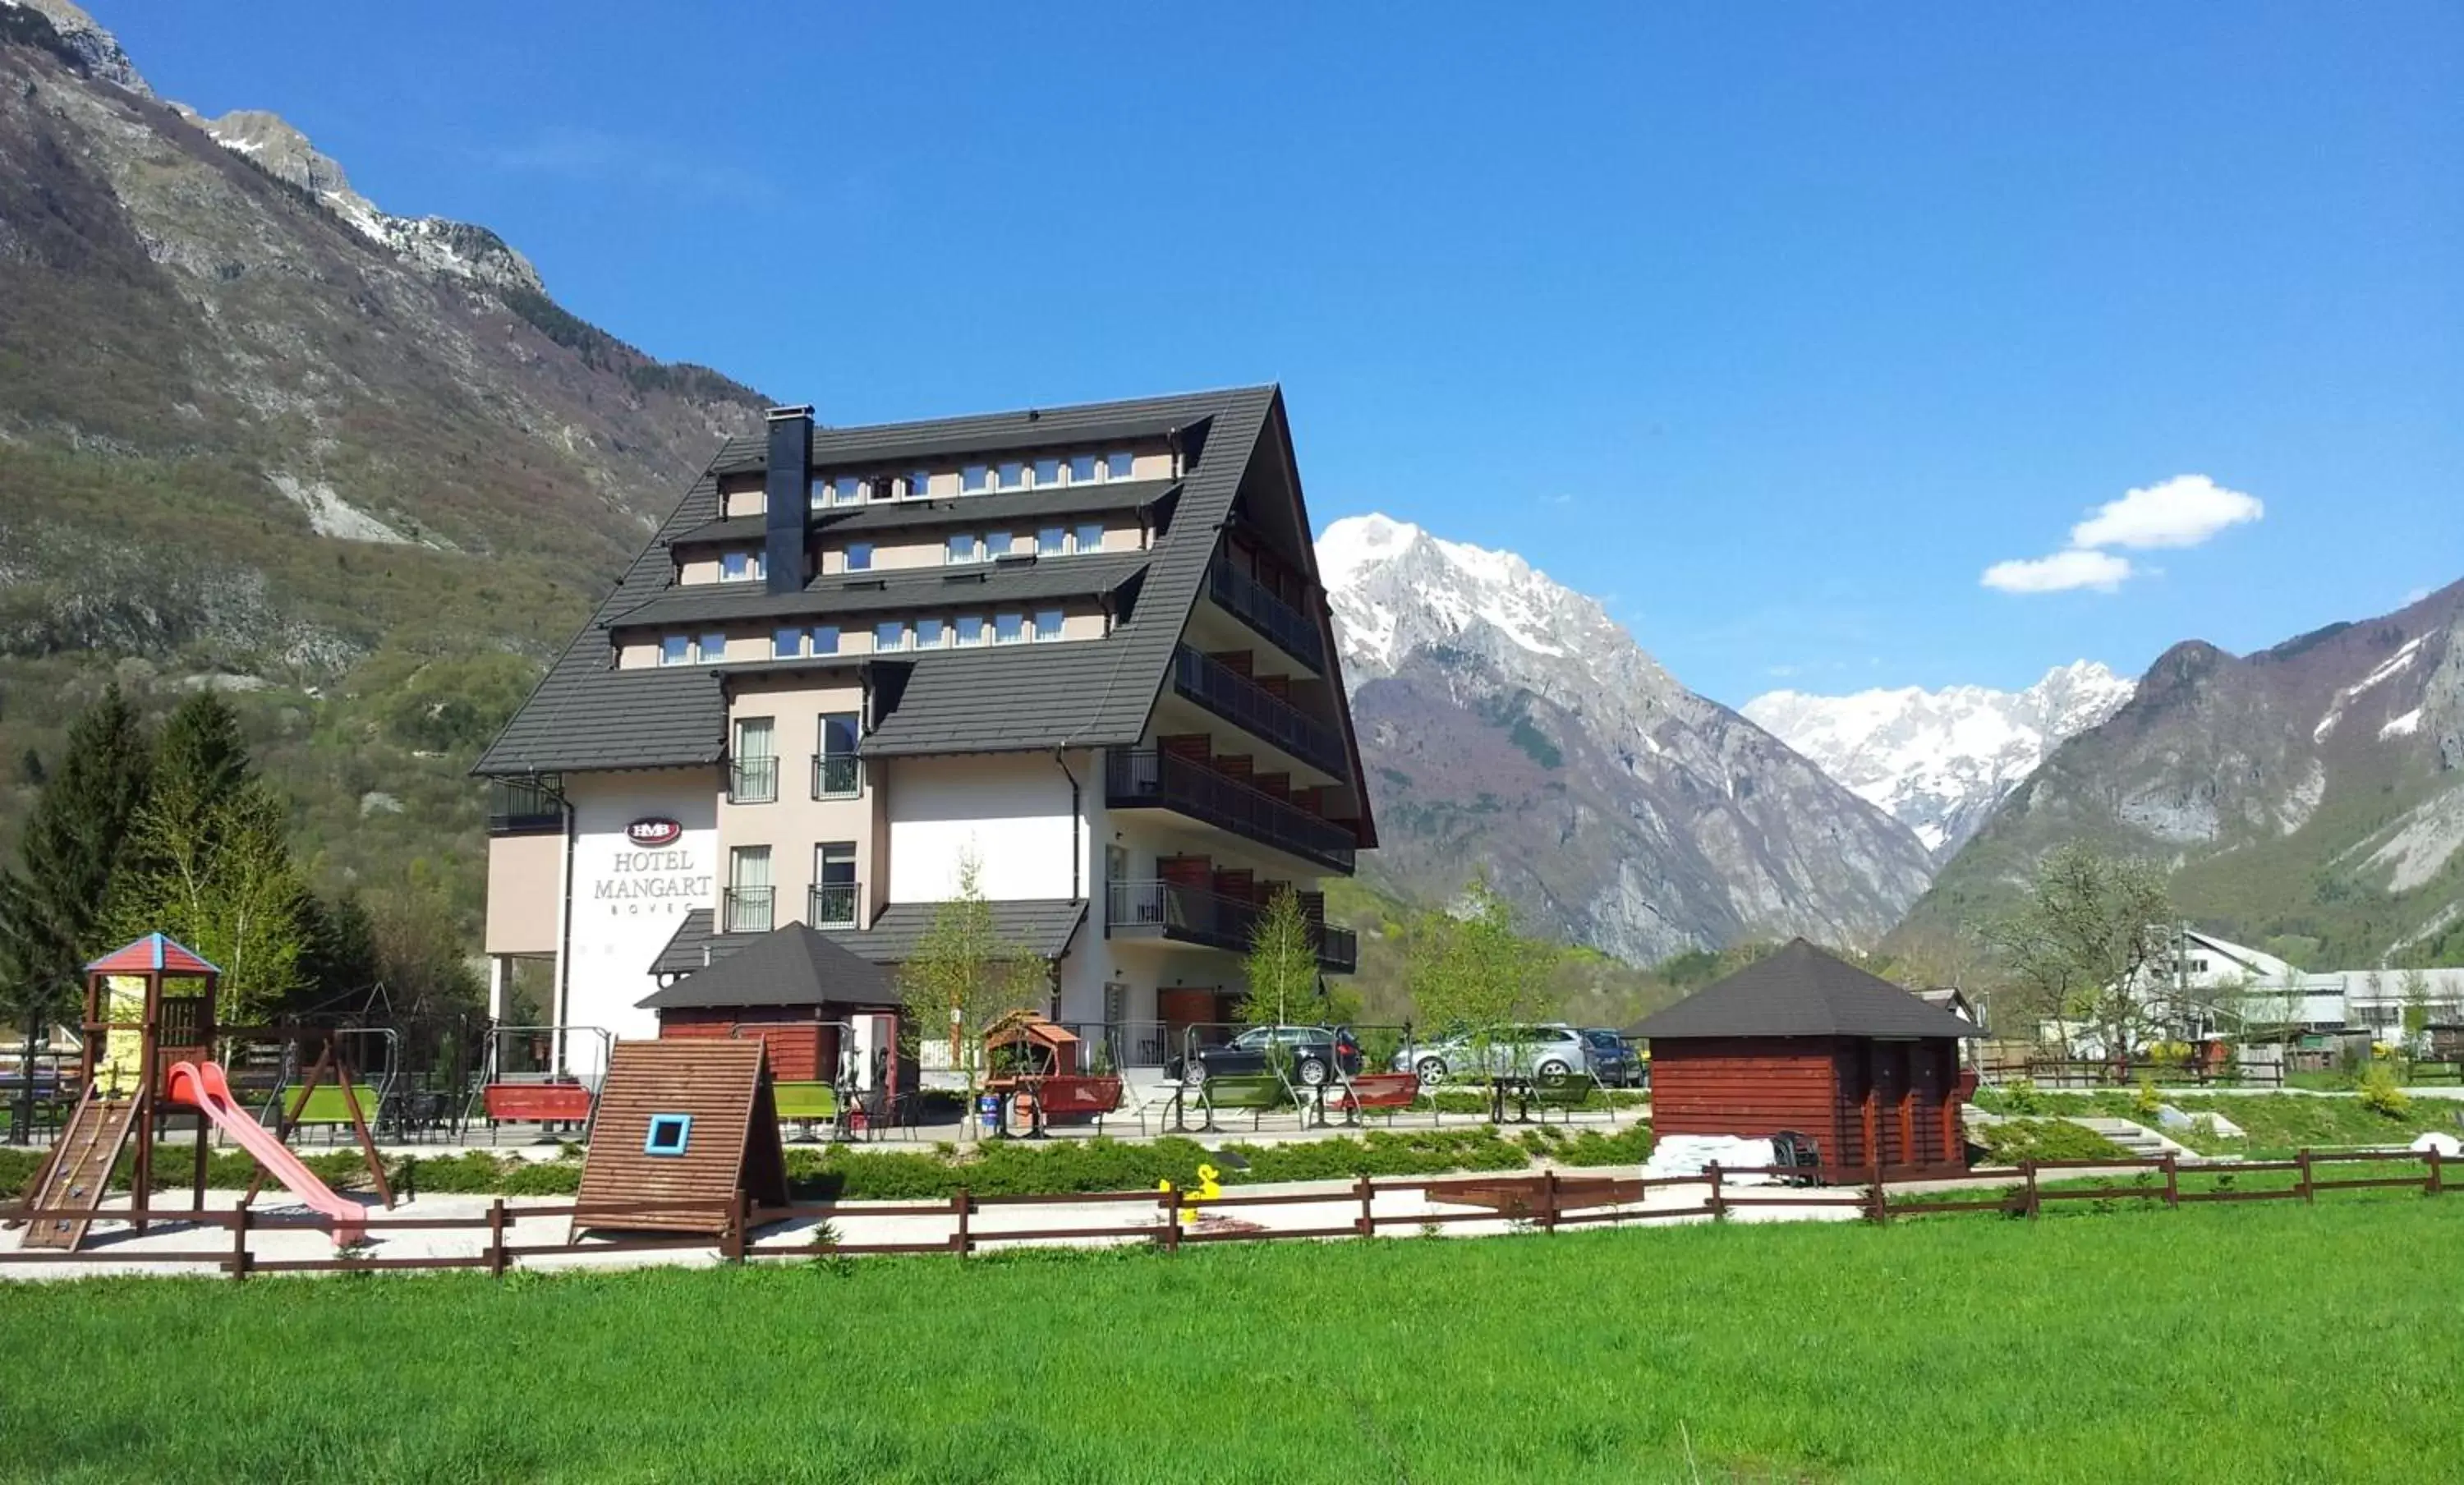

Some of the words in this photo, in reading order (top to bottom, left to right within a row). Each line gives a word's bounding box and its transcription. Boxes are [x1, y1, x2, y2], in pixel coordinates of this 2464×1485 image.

[632, 823, 670, 837] HMB
[614, 851, 694, 872] HOTEL
[595, 876, 712, 899] MANGART
